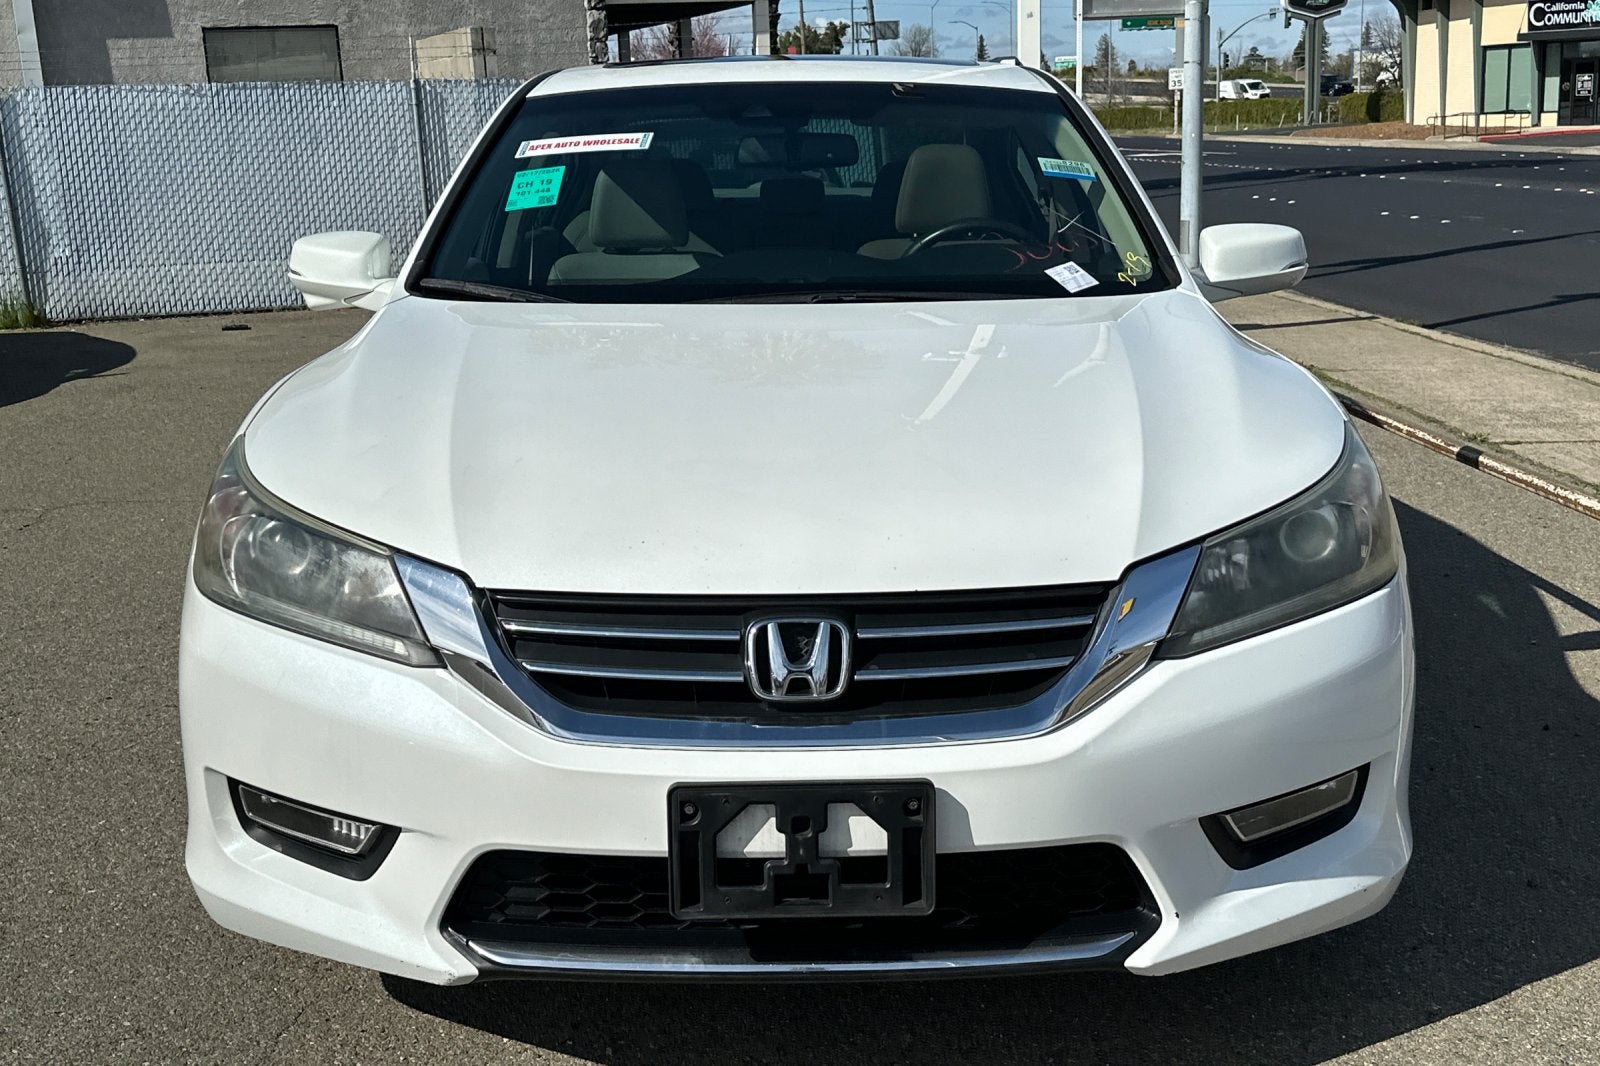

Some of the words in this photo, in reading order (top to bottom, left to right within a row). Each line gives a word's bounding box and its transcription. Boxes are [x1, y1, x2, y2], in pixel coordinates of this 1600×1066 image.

[1544, 2, 1585, 12] California
[1171, 79, 1183, 88] 35
[528, 143, 553, 152] APEX
[554, 140, 580, 149] AUTO
[583, 137, 640, 147] WHOLESALE
[540, 178, 553, 186] 19
